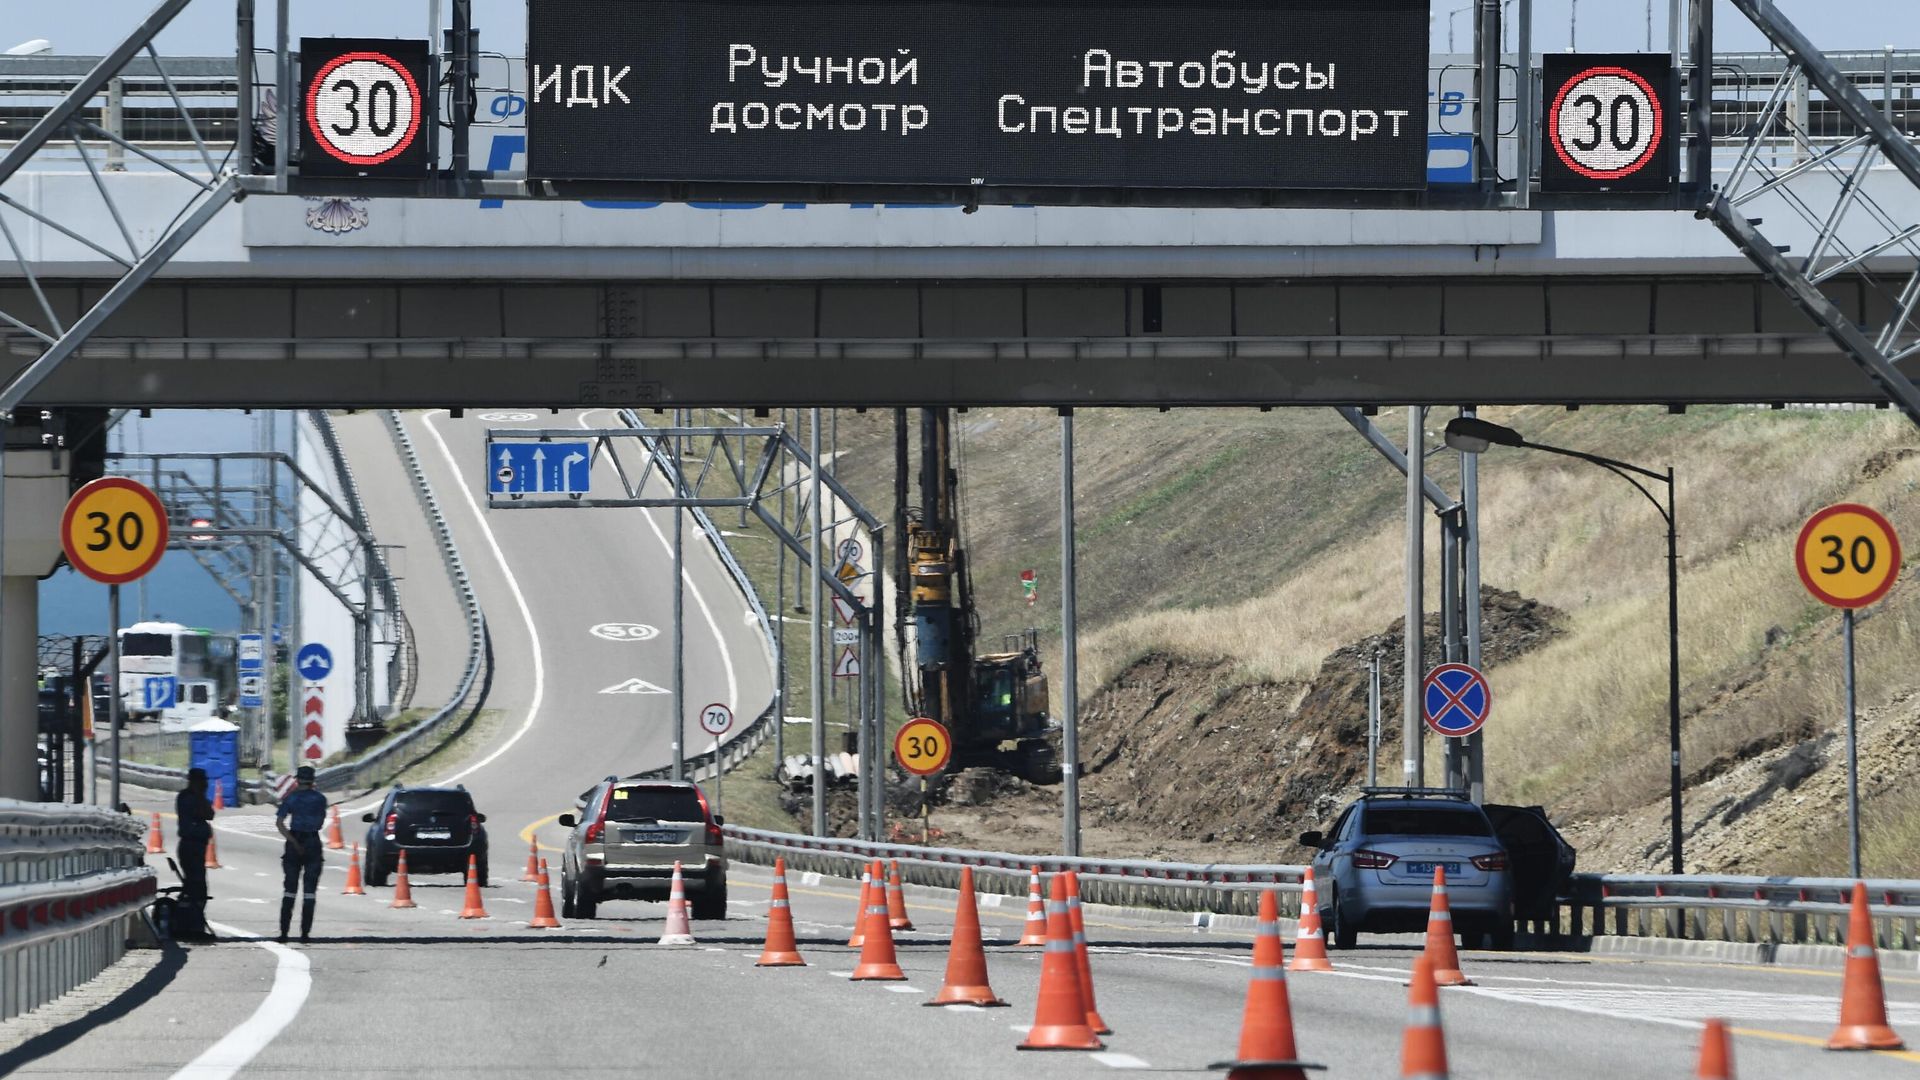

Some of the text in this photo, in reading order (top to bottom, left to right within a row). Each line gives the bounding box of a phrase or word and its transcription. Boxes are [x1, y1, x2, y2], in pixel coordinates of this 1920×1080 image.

[729, 43, 918, 88] Ручной
[1083, 48, 1335, 94] Автобусы
[533, 64, 631, 109] ИДК
[331, 79, 397, 137] 30
[710, 102, 929, 136] досмотр
[998, 94, 1409, 141] Спецтранспорт
[1572, 94, 1640, 151] 30
[86, 511, 145, 552] 30
[1820, 534, 1876, 575] 30
[602, 626, 650, 638] 50
[835, 631, 854, 642] 200
[707, 711, 726, 726] 70
[907, 735, 939, 759] 30
